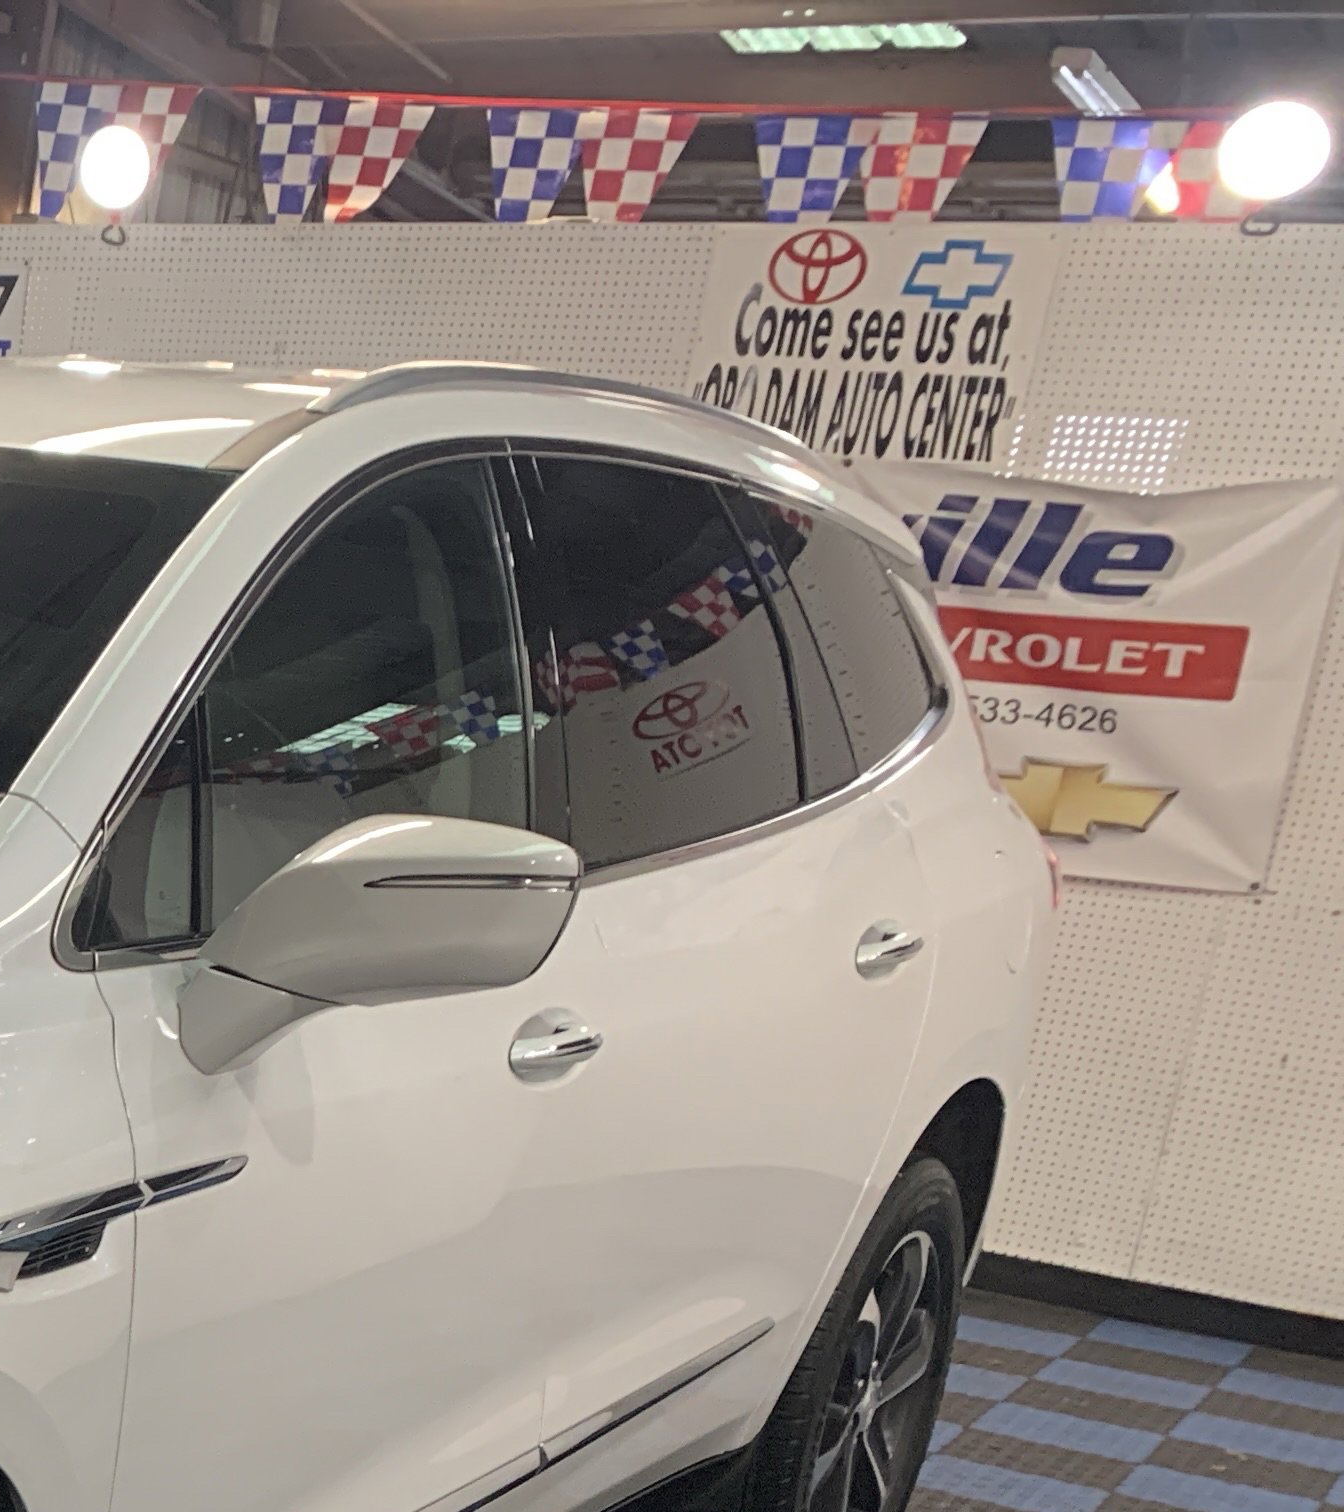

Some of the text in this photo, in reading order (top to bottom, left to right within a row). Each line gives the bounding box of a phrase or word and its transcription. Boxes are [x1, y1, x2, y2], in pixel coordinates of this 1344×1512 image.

[735, 282, 1011, 371] Come see us at,
[762, 367, 827, 449] DAM
[820, 370, 903, 458] AUTO
[904, 373, 1017, 462] CENTER"
[902, 494, 1174, 597] ille
